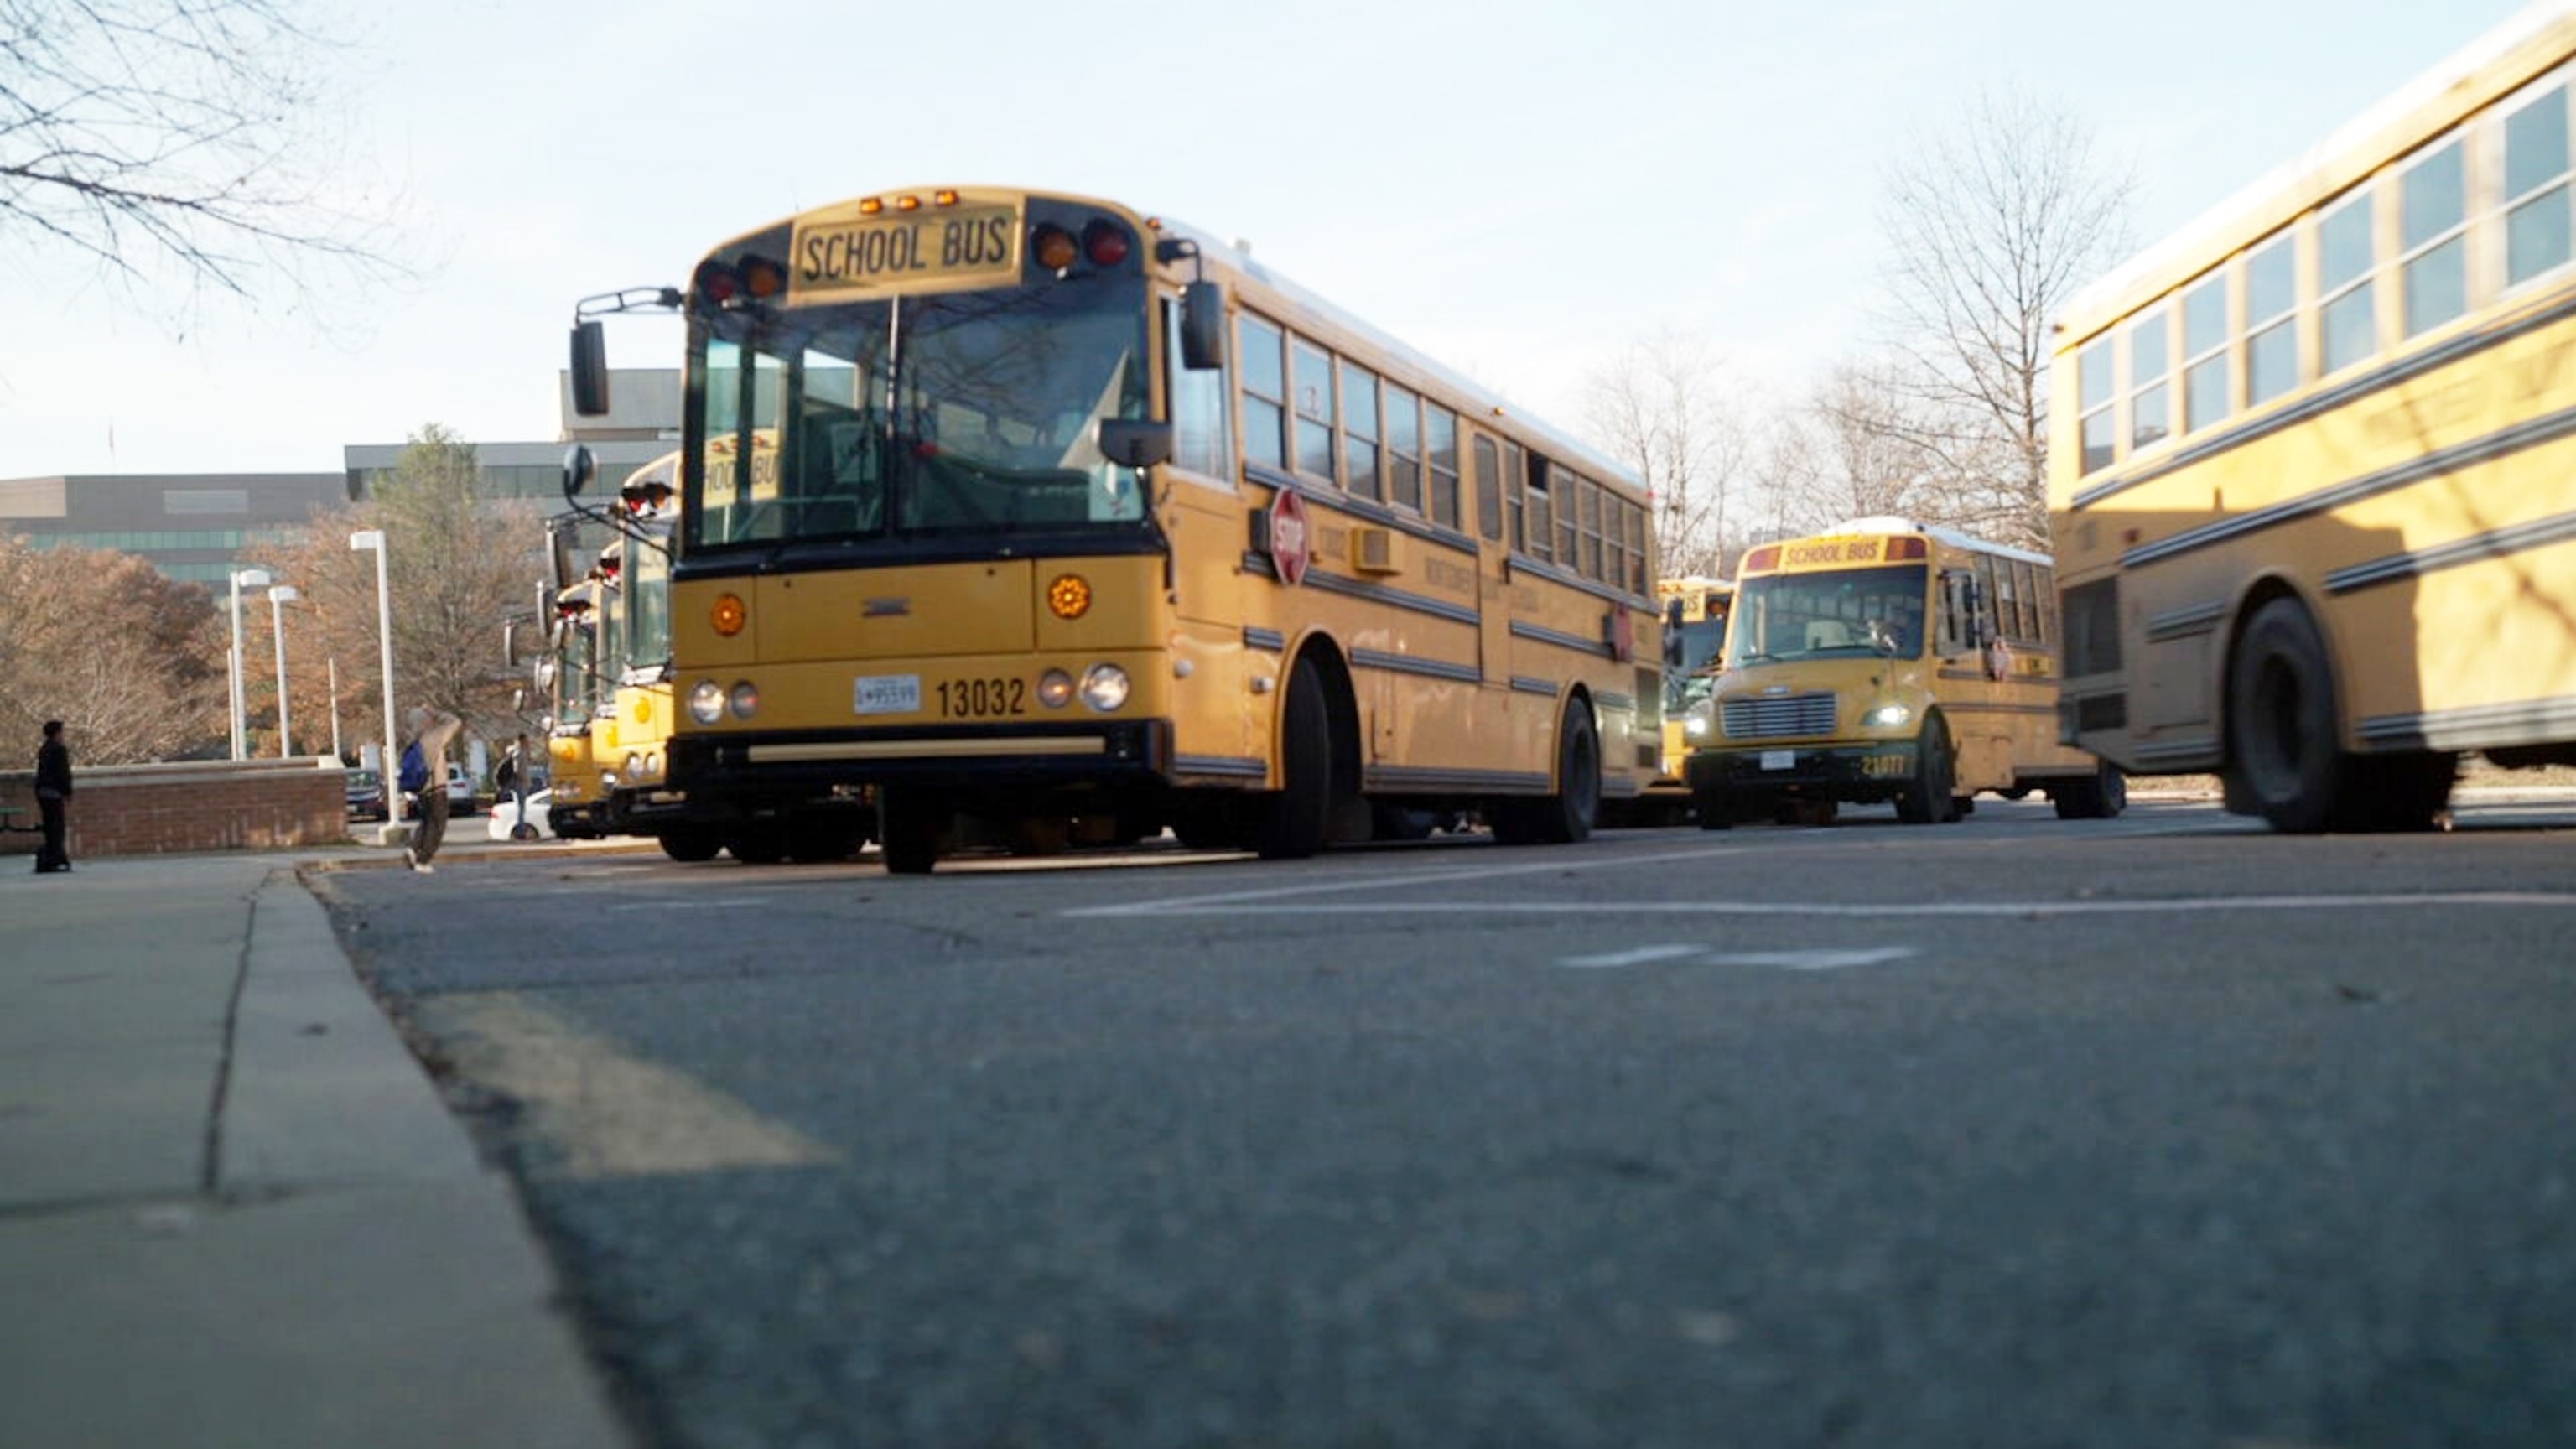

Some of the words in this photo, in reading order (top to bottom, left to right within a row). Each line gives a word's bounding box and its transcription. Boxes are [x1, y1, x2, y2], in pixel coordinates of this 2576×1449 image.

[804, 225, 926, 281] SCHOOL
[943, 216, 1006, 267] BUS
[1276, 517, 1304, 554] STOP
[1786, 545, 1841, 565] SCHOOL
[1847, 542, 1877, 561] BUS
[937, 678, 1025, 717] 13032
